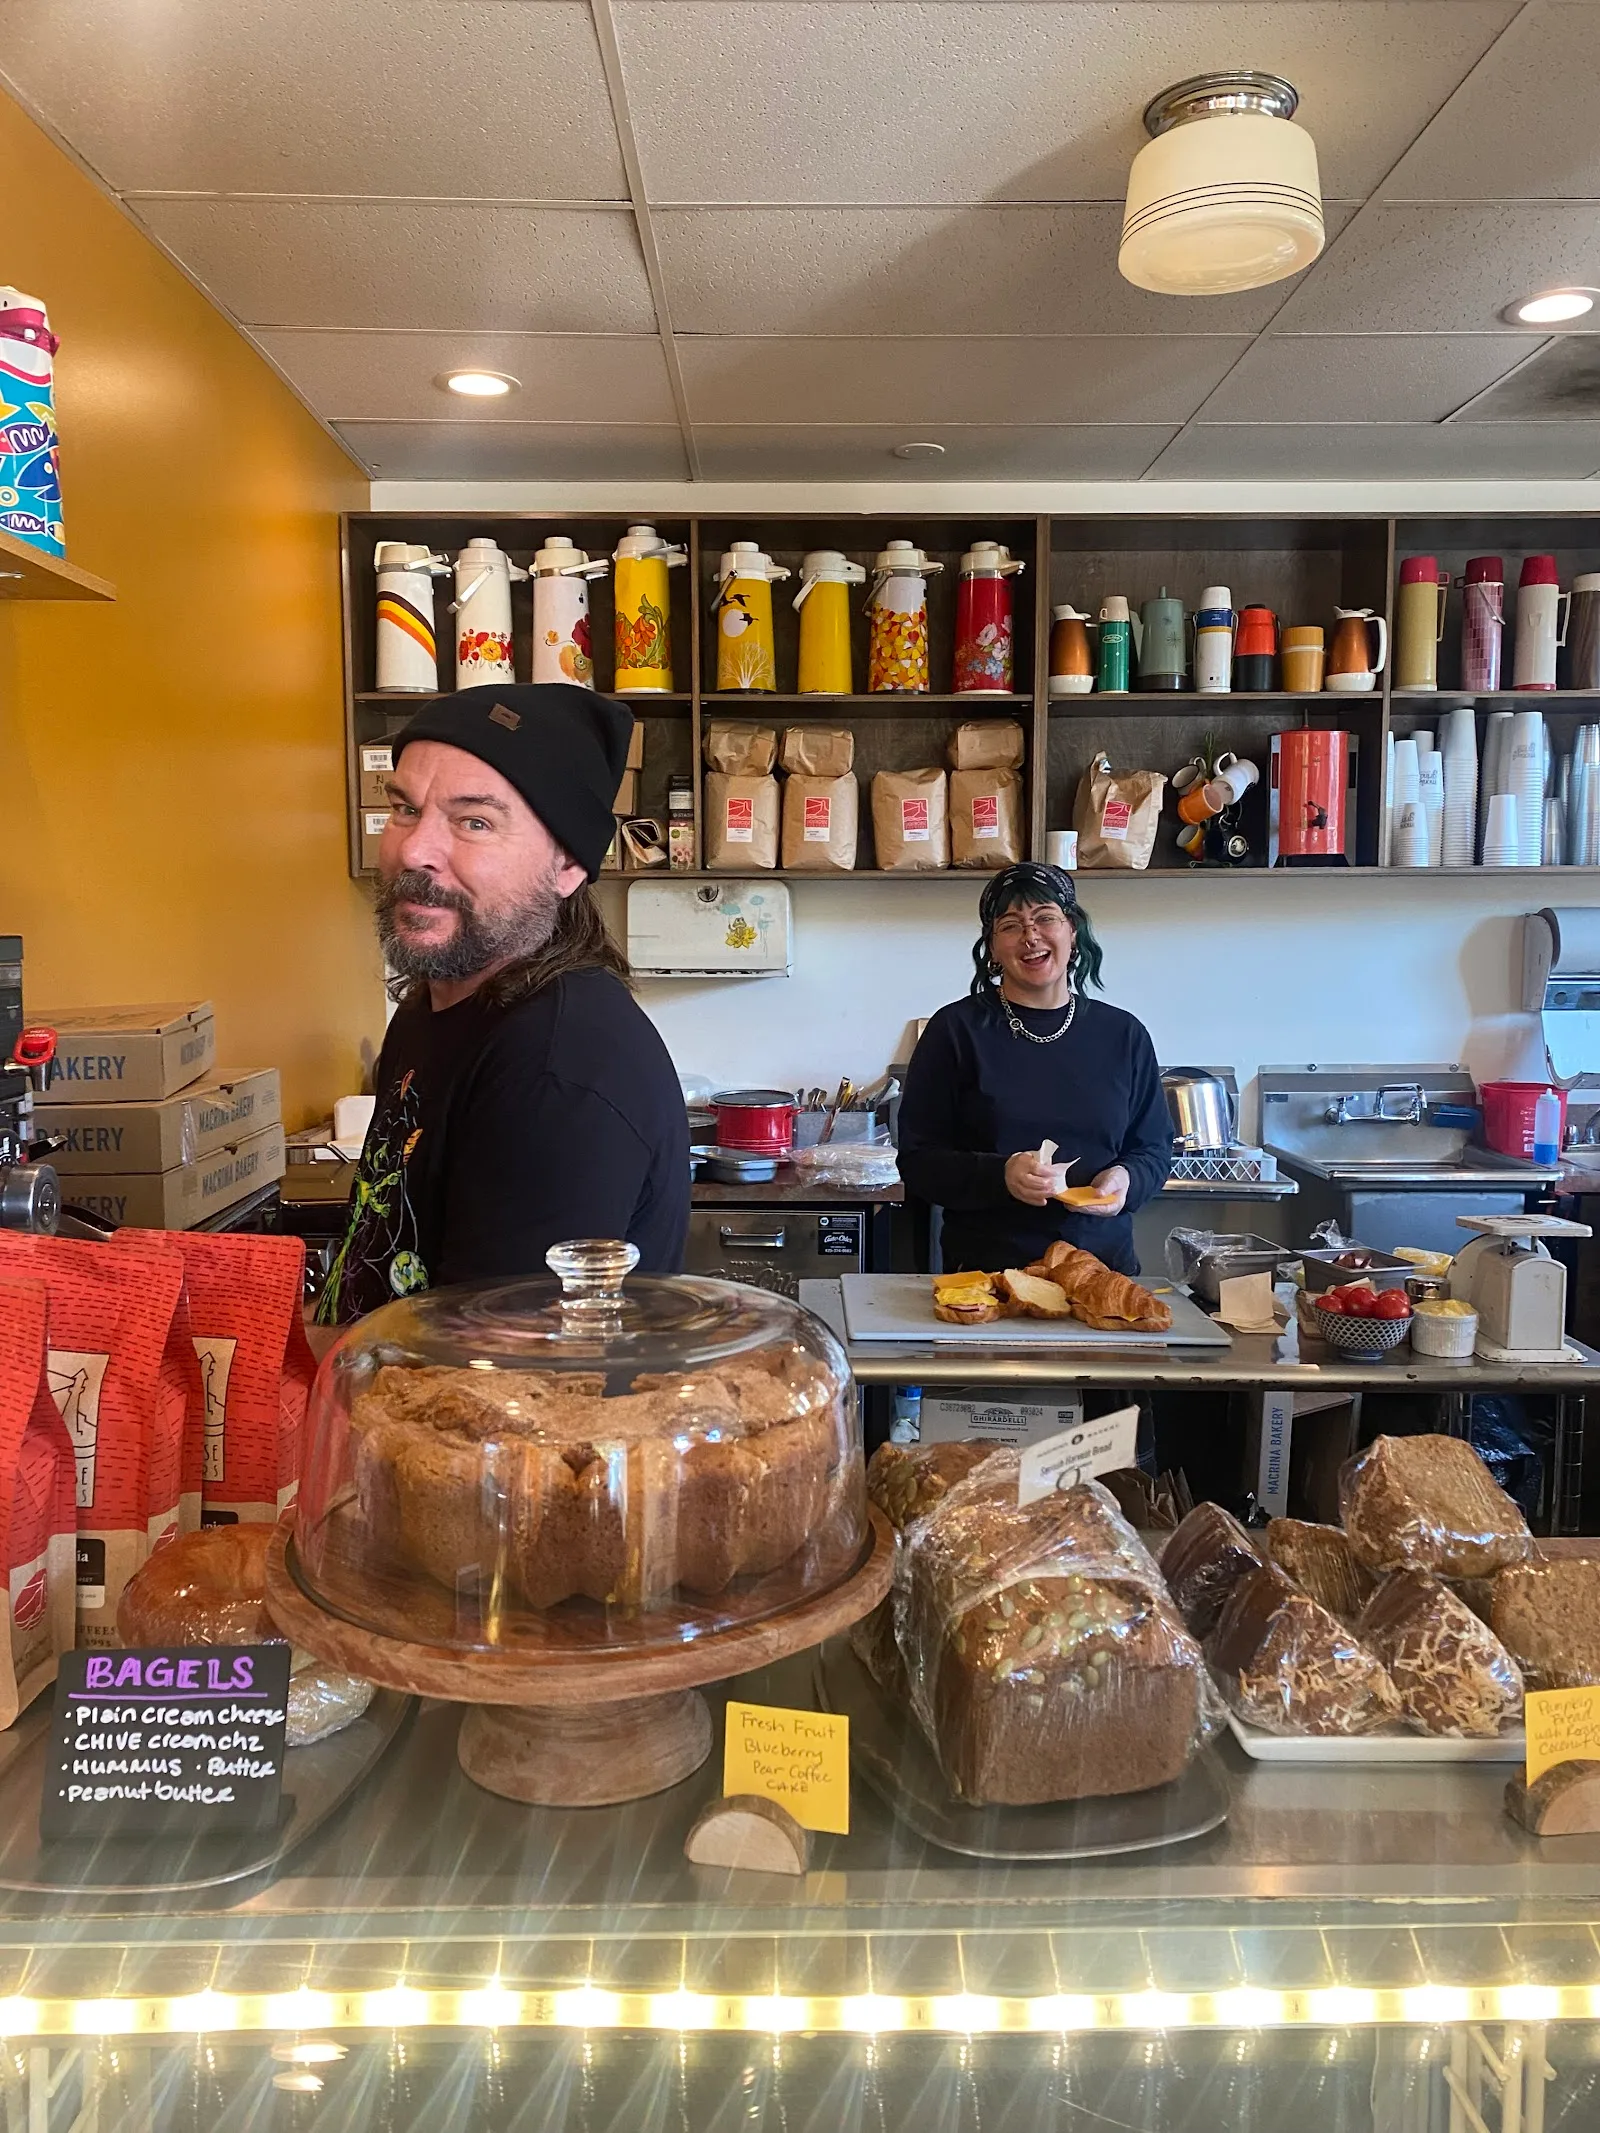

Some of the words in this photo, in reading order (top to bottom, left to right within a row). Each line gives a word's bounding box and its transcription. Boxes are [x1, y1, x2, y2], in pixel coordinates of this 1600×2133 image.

[50, 1056, 126, 1081] AKERY
[973, 1415, 1025, 1424] GHIRARDELLI
[1271, 1407, 1284, 1446] BAKERY
[1267, 1449, 1281, 1495] MACRINA
[86, 1656, 254, 1690] BAGELS
[76, 1706, 137, 1726] Plain
[740, 1711, 785, 1733] Fresh
[794, 1719, 836, 1740] Fruit
[74, 1731, 142, 1751] CHIVE
[744, 1738, 823, 1766] Blueberry
[753, 1761, 785, 1776] Pear
[789, 1764, 832, 1783] Coffee
